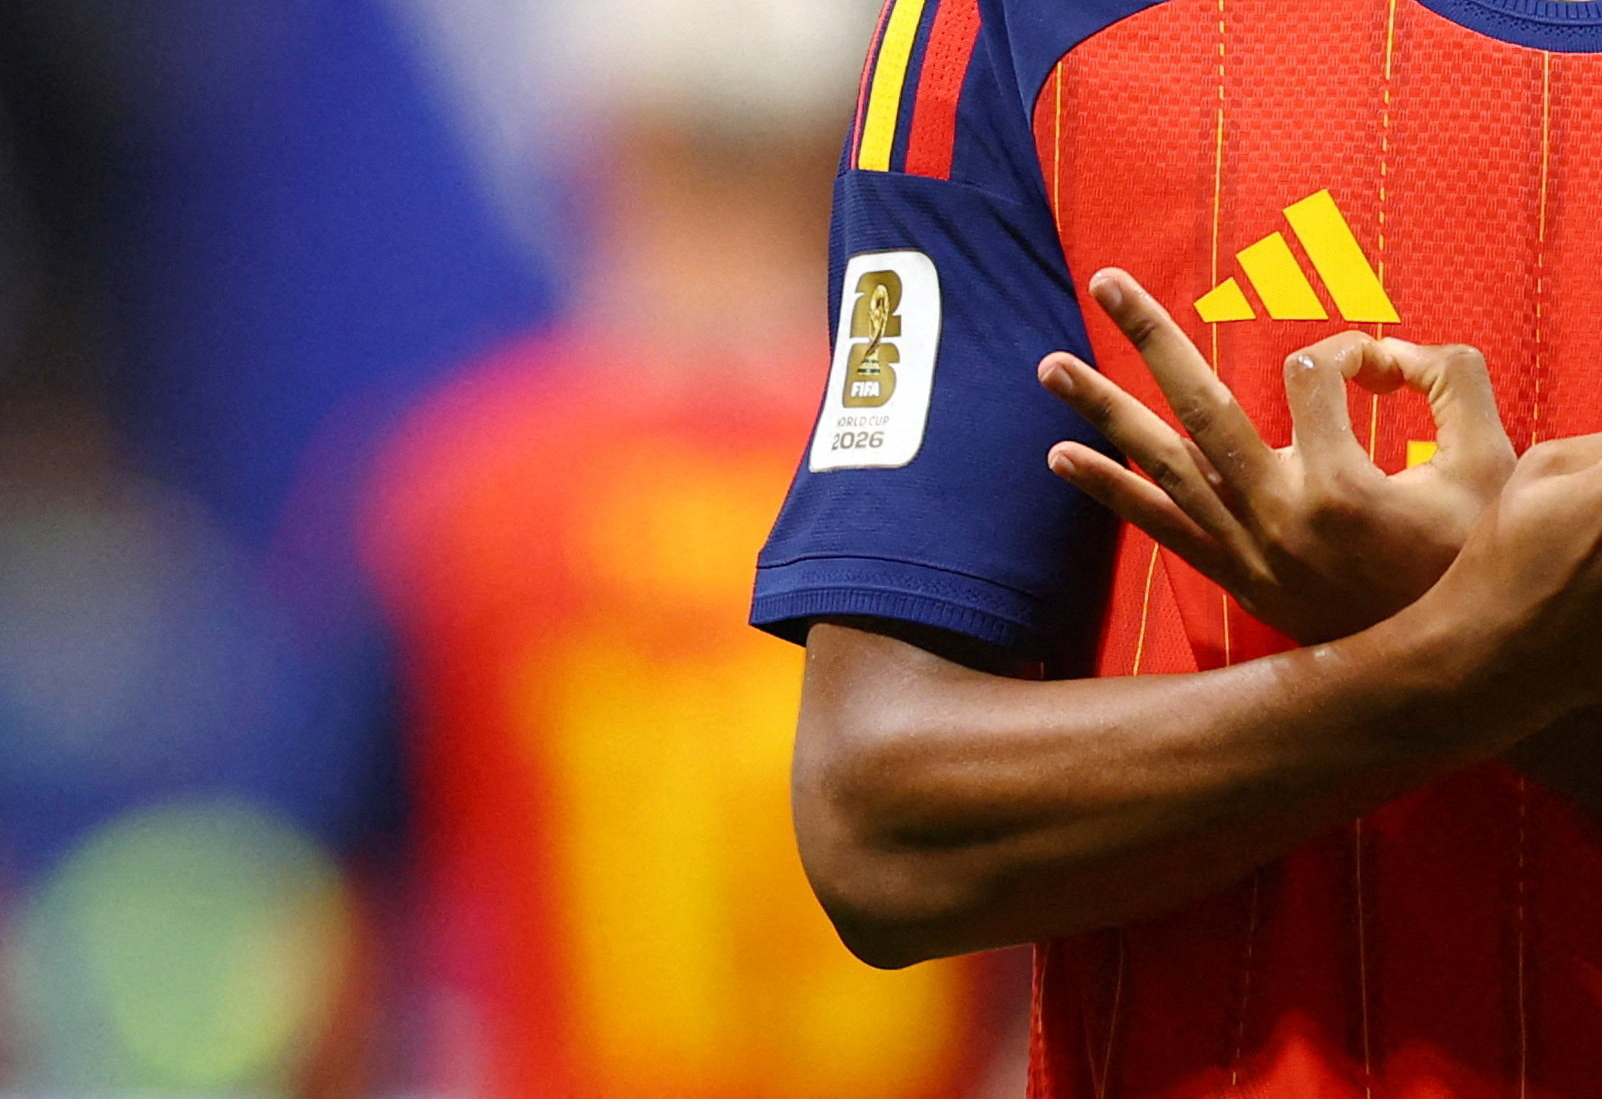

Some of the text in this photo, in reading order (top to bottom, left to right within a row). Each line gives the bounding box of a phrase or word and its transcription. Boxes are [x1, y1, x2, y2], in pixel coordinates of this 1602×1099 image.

[850, 381, 880, 397] FIFA
[868, 415, 890, 427] CUP
[831, 431, 885, 451] 2026
